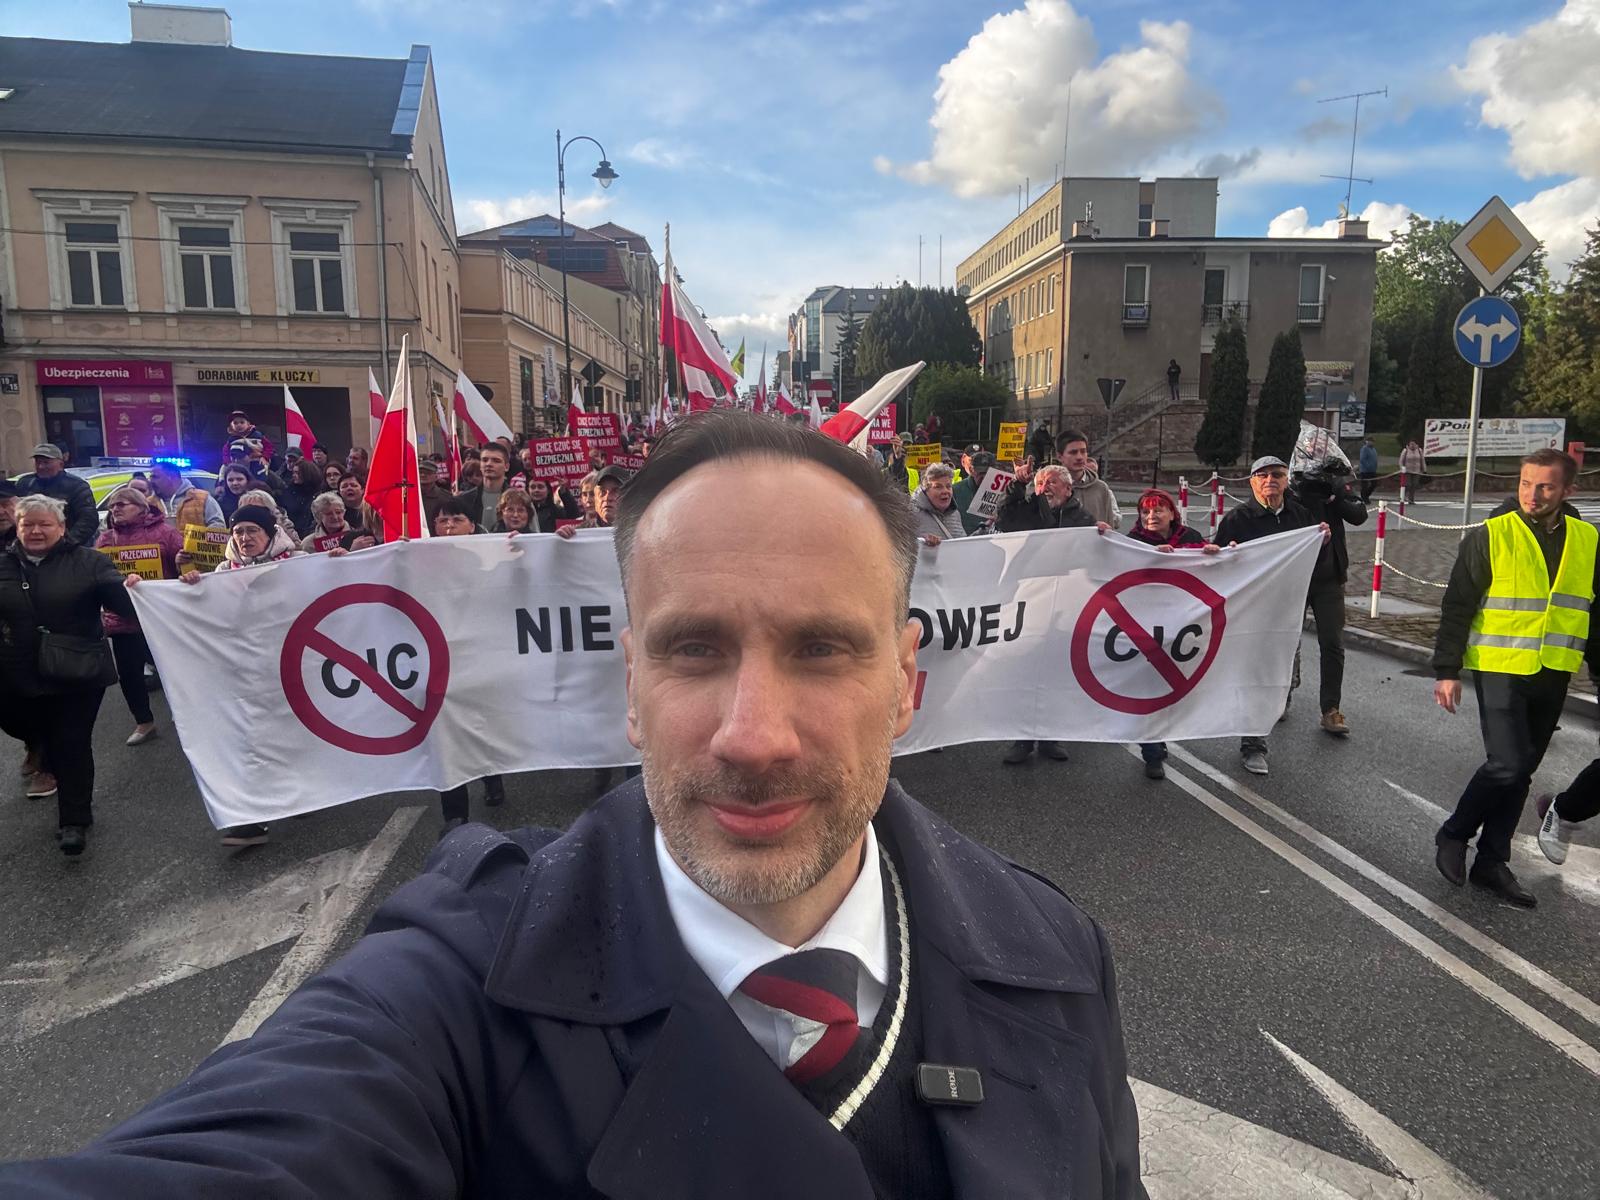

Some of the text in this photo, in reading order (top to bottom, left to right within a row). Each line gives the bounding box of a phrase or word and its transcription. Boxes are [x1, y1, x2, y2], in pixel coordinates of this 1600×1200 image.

[44, 366, 130, 379] Ubezpieczenia
[197, 369, 314, 382] DORABIANIE KLUCZY
[881, 418, 891, 428] WE
[1438, 420, 1484, 431] Poit
[871, 429, 894, 440] KRAJU!
[535, 439, 582, 454] CHCĘ CZUĆ SIĘ
[535, 451, 585, 466] BEZPIECZNA WE
[120, 548, 158, 561] PRZECIWKO
[515, 606, 614, 654] NIE
